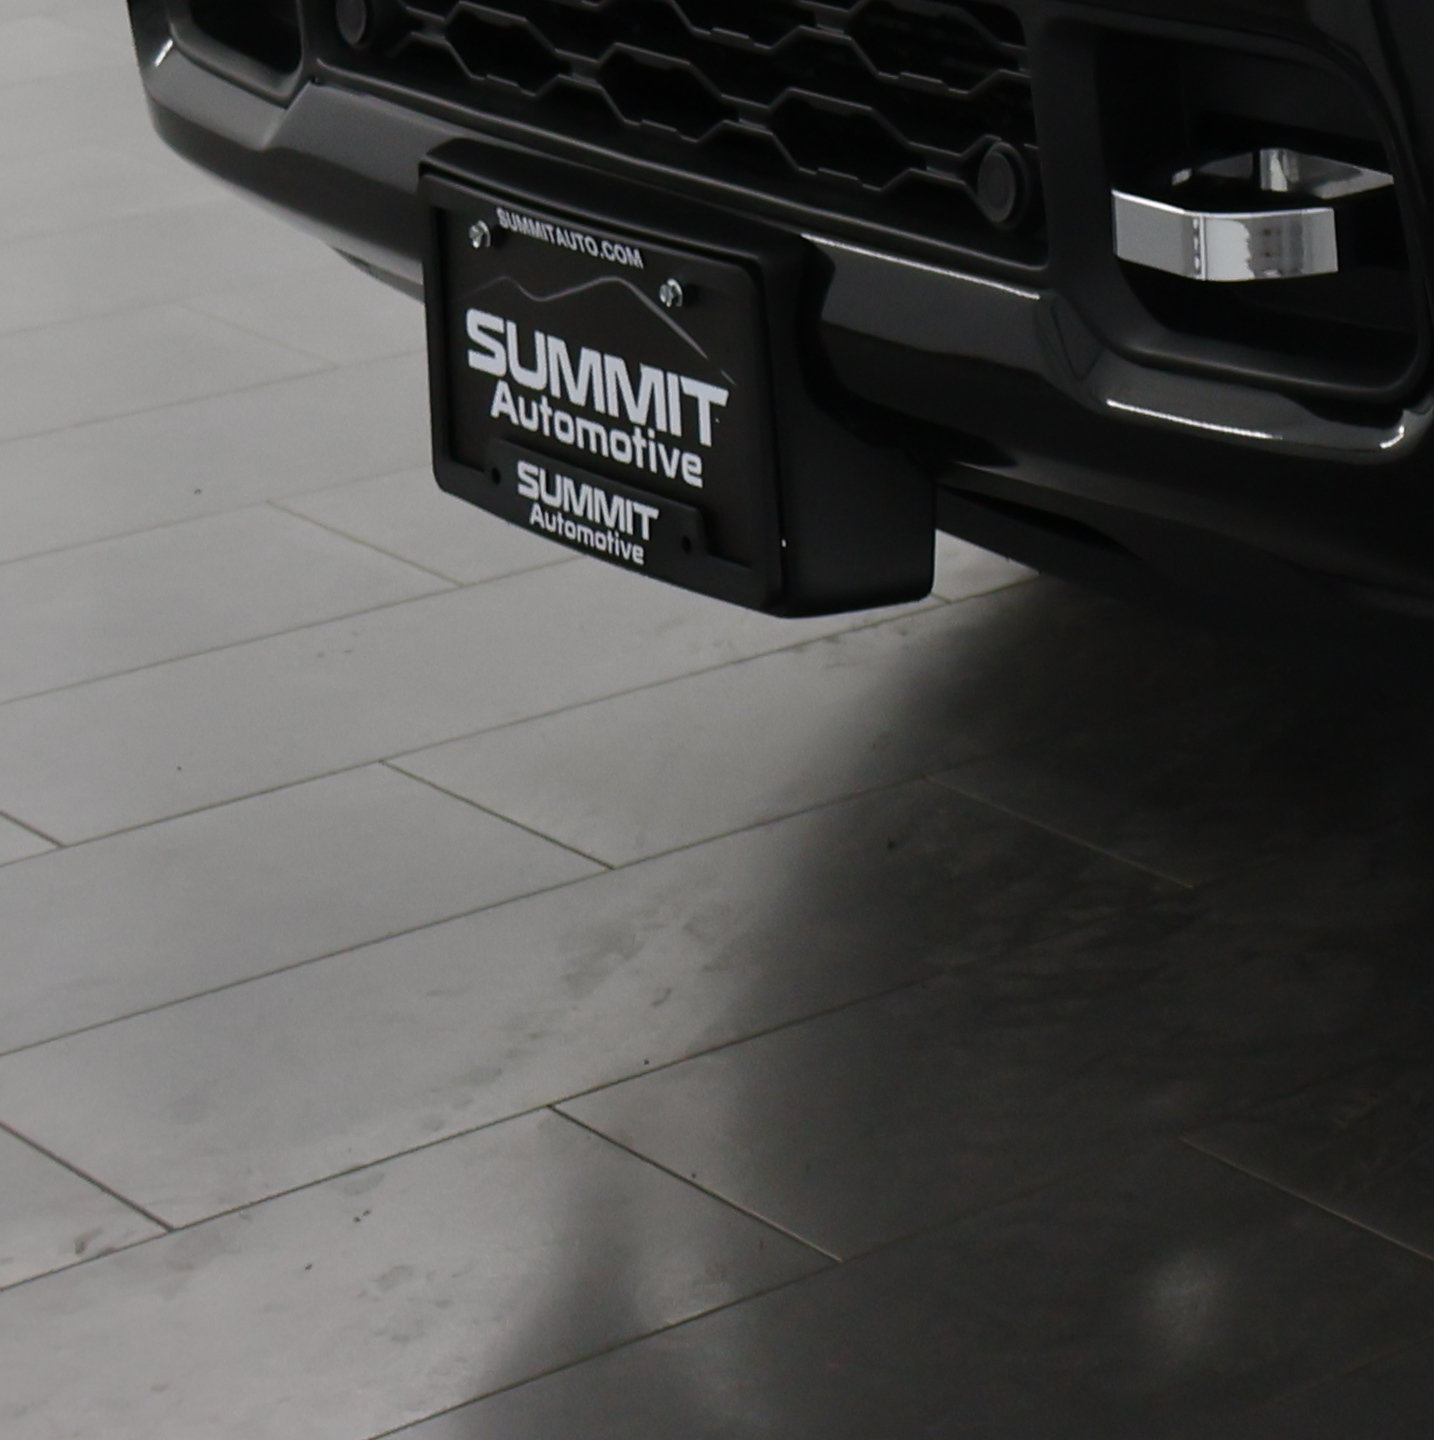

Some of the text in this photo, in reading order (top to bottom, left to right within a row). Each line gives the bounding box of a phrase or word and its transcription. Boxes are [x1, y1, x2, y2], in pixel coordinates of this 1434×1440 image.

[496, 207, 645, 270] SUMMITAUTO.COM
[466, 308, 730, 447] SUMMIT
[490, 379, 704, 488] Automotive
[517, 461, 660, 541] SUMMIT
[529, 502, 645, 566] Automotive
